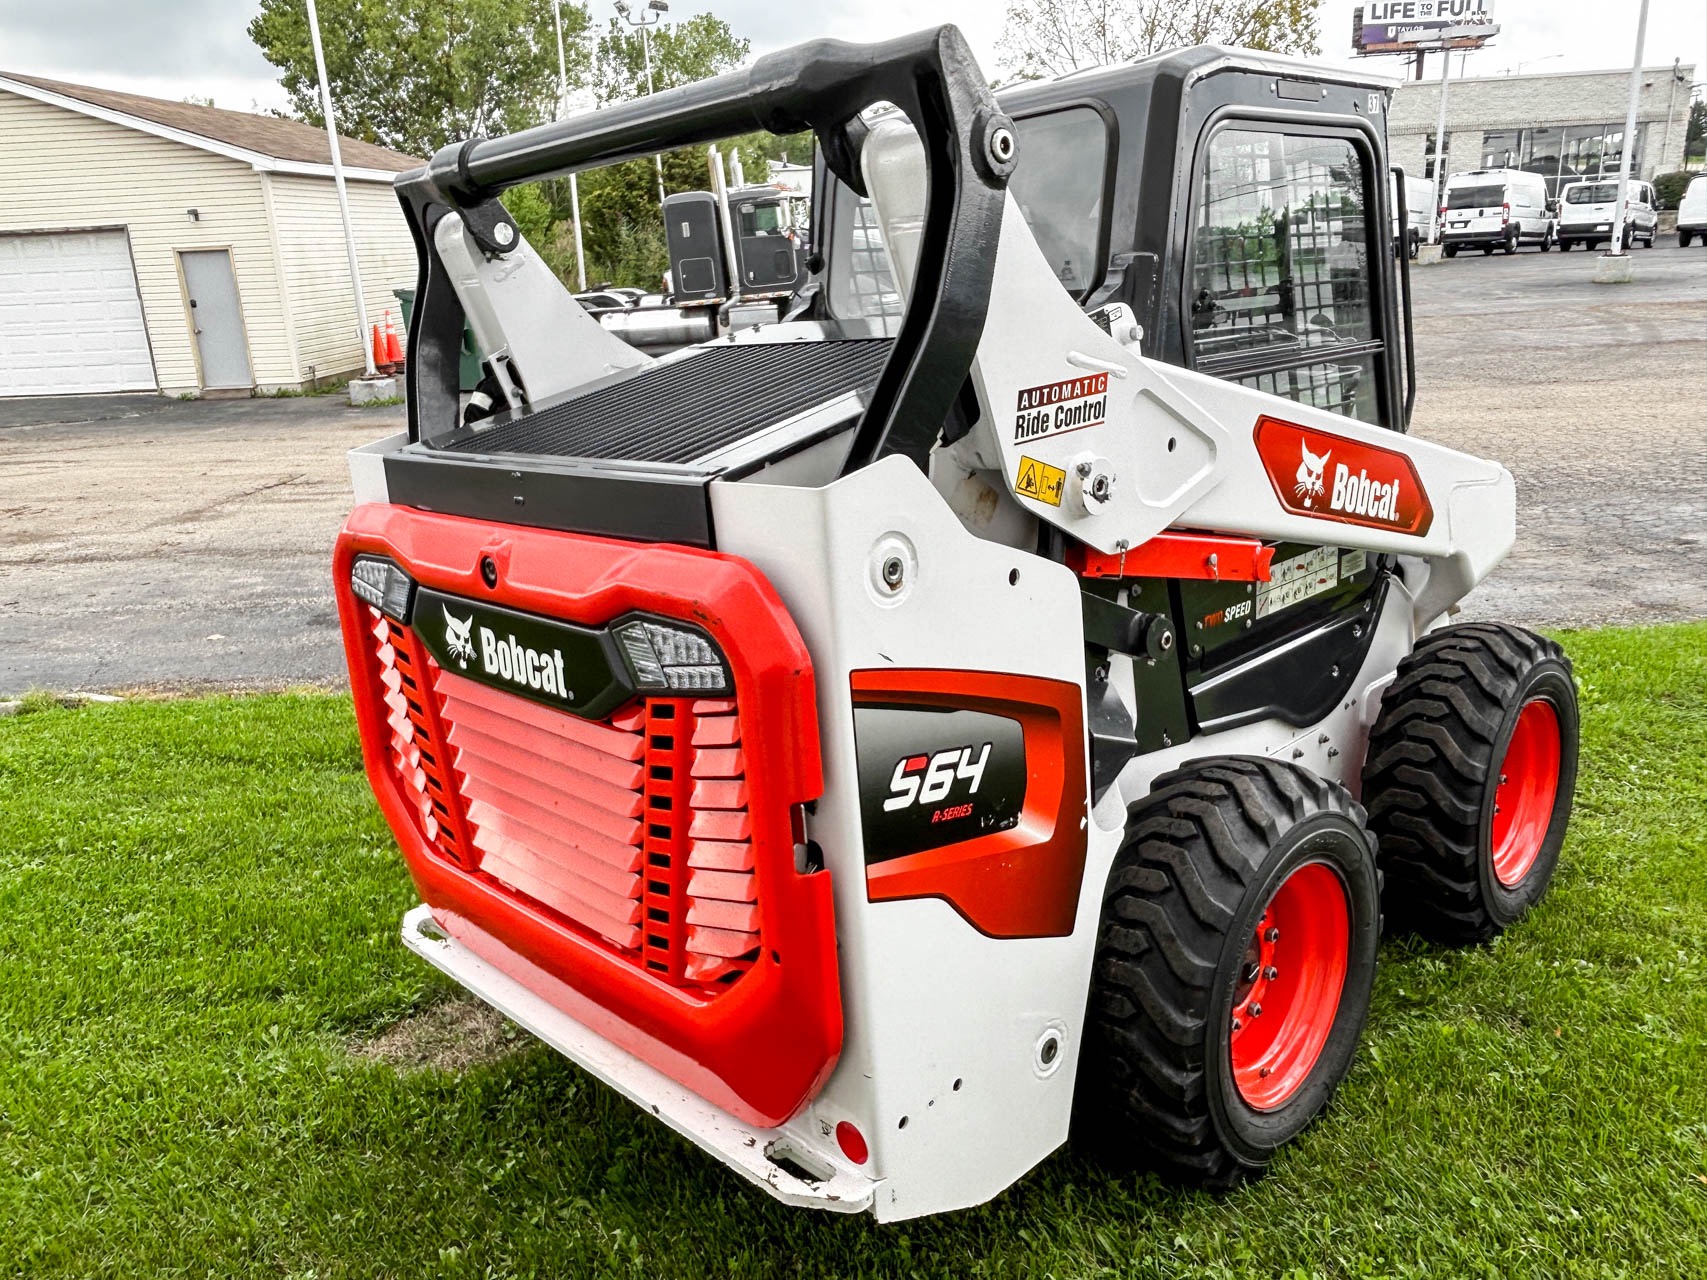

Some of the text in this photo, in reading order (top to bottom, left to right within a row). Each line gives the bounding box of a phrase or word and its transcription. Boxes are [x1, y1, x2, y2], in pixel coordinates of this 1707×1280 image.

[1371, 2, 1415, 20] LIFE
[1420, 3, 1432, 11] TO
[1020, 376, 1105, 409] AUTOMATIC
[1015, 394, 1107, 440] Ride Control
[1330, 462, 1400, 522] Bobcat
[1224, 599, 1251, 623] SPEED
[479, 626, 568, 699] Bobcat
[883, 743, 992, 812] S64
